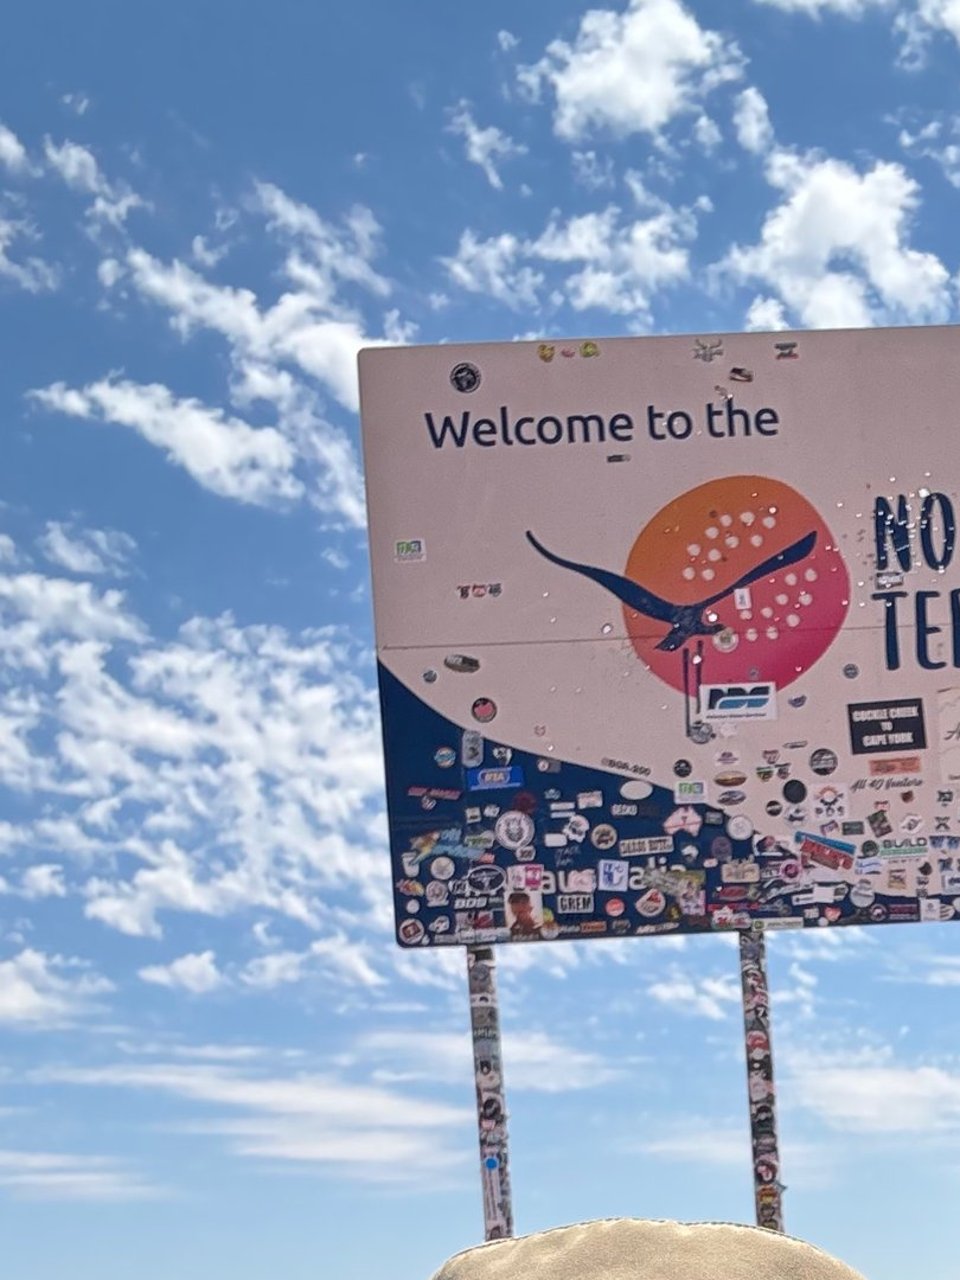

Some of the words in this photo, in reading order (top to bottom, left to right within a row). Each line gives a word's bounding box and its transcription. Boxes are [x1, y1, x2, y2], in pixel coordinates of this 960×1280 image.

[425, 406, 633, 449] Welcome
[647, 405, 693, 441] to
[706, 400, 780, 439] the
